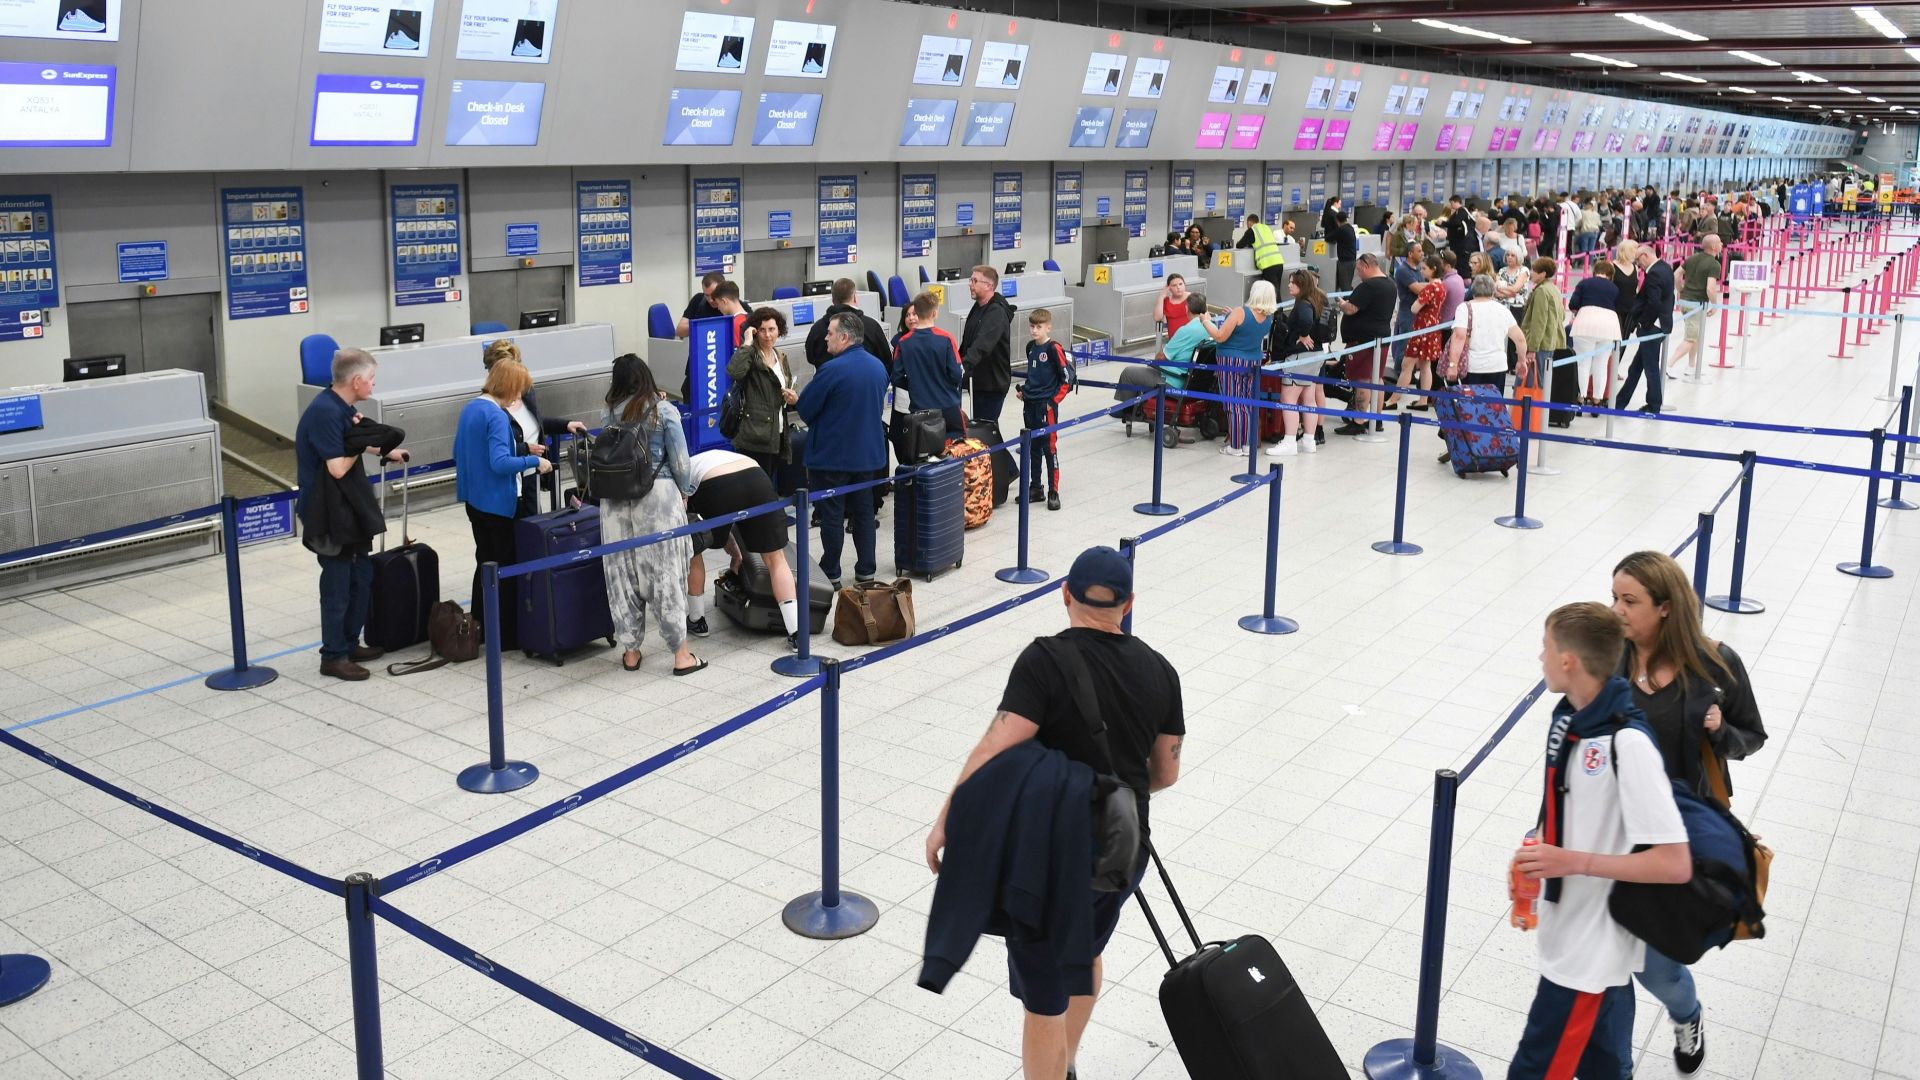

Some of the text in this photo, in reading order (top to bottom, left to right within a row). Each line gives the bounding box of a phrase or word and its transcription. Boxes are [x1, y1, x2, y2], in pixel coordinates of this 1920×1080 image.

[63, 71, 108, 79] SunExpress
[468, 101, 525, 112] Check-in Desk
[682, 107, 725, 117] Check-in Desk
[768, 110, 808, 119] Check-in Desk
[481, 115, 508, 125] Closed
[691, 119, 712, 128] Closed
[777, 121, 796, 129] Closed
[246, 503, 274, 514] NOTICE
[261, 523, 280, 531] placing
